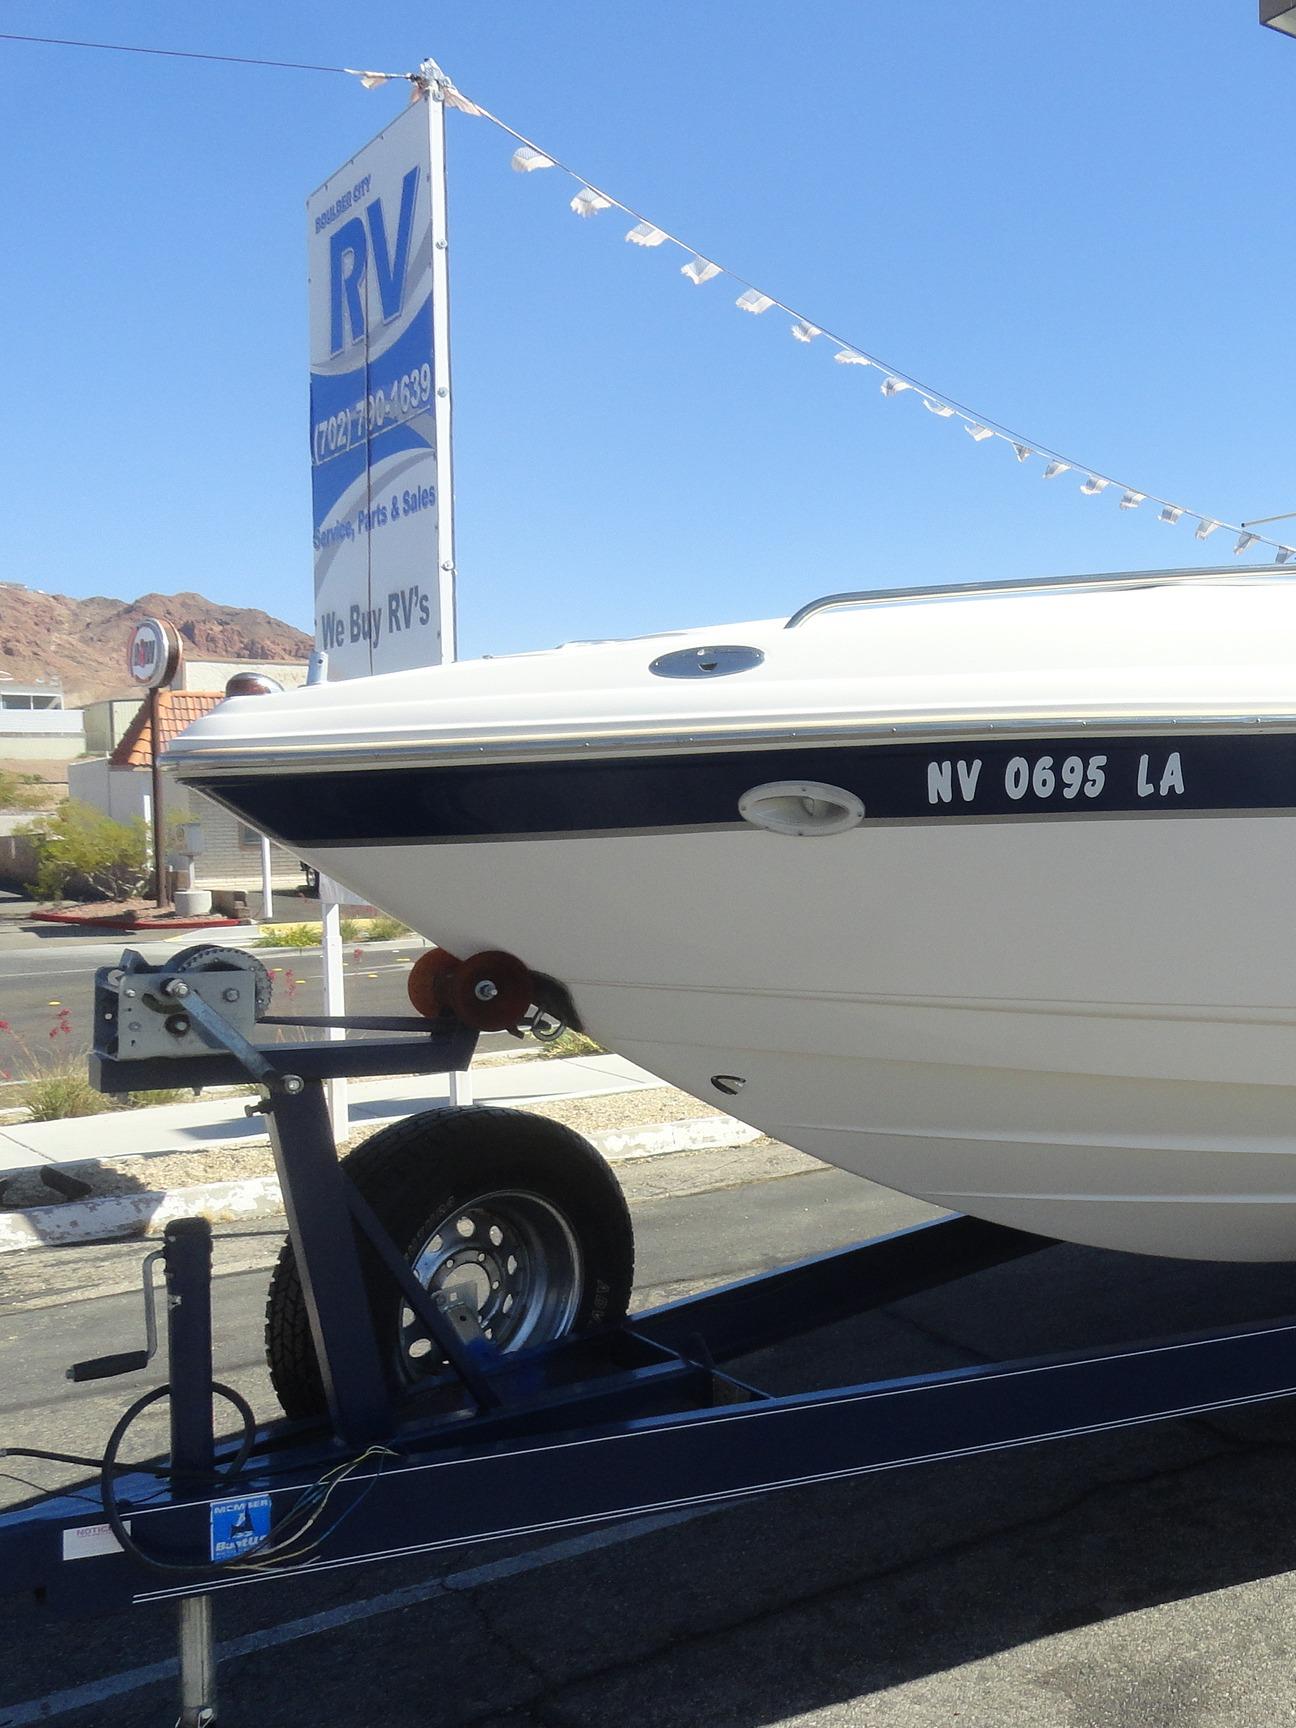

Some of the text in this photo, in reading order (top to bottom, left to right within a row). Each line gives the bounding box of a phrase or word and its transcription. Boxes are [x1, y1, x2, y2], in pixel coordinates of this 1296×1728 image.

[314, 173, 372, 234] BOULDER CITY
[330, 165, 420, 360] RV
[314, 408, 351, 464] (702)
[358, 504, 388, 534] Parts
[391, 495, 400, 521] &
[402, 484, 436, 516] Sales
[321, 584, 430, 650] We Buy RV's
[927, 752, 1185, 804] NV 0695 LA
